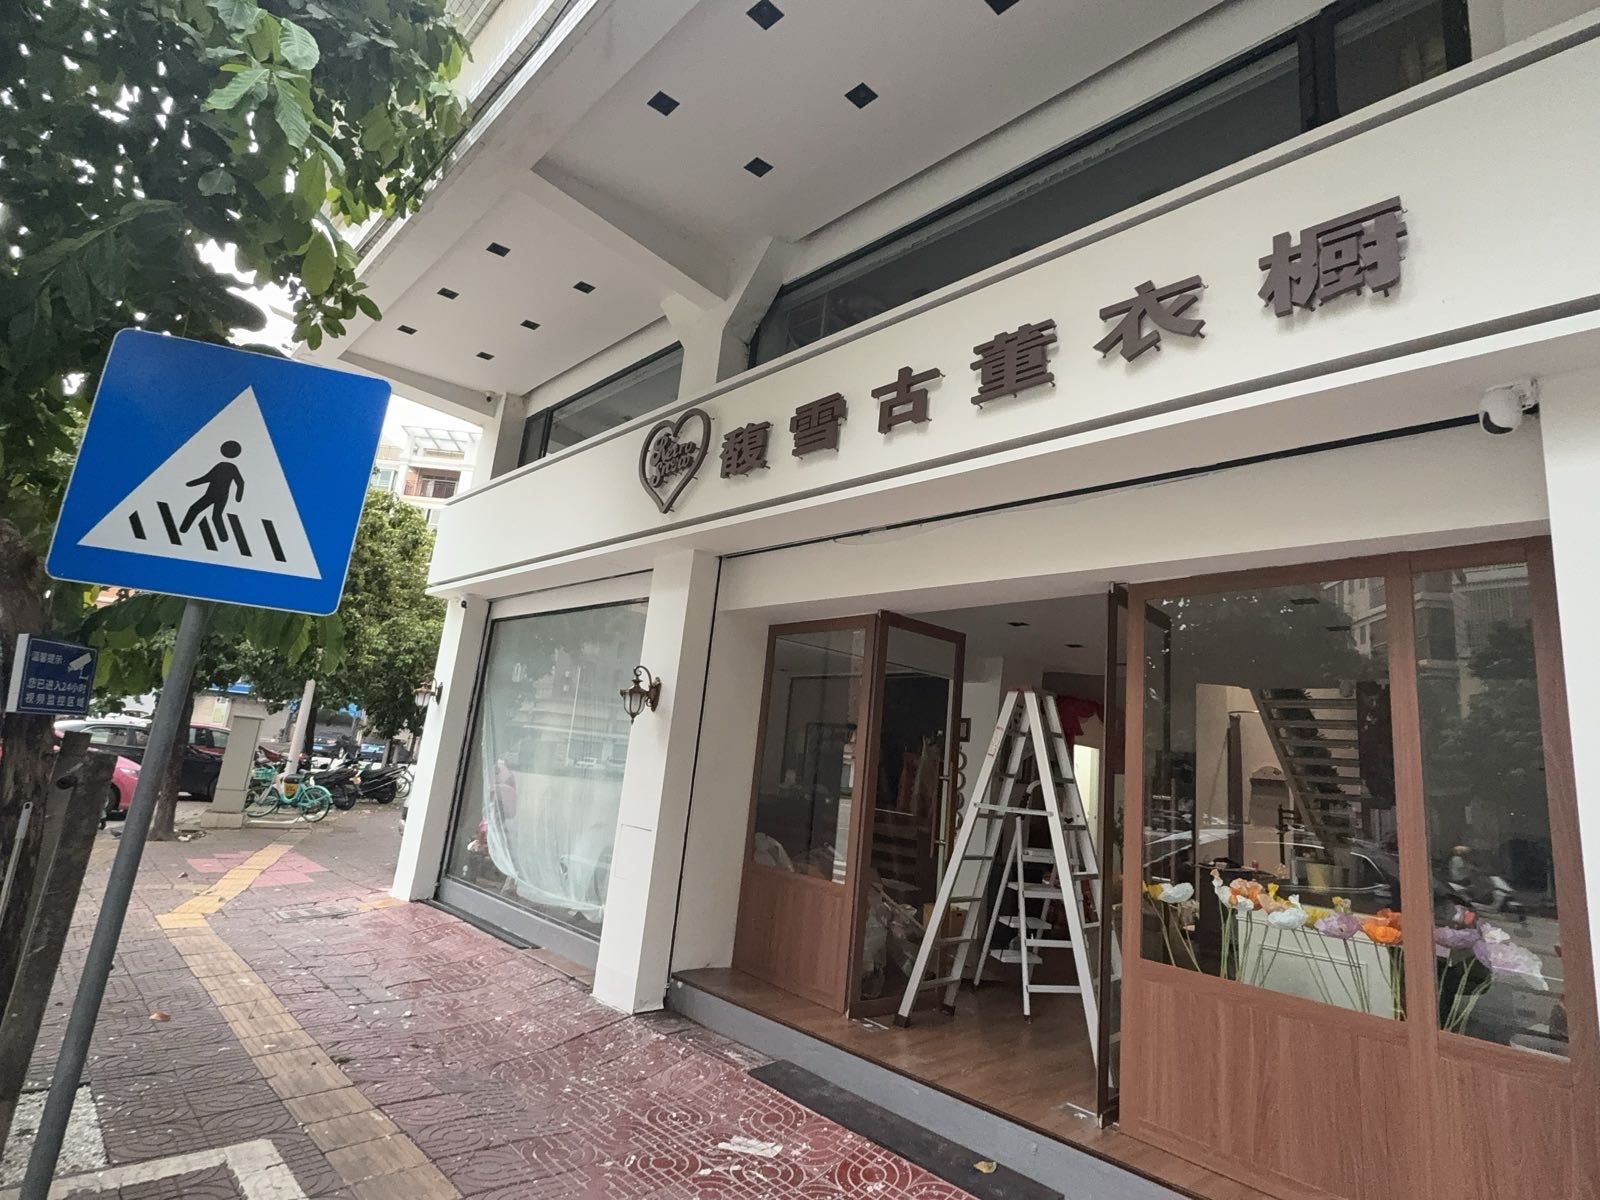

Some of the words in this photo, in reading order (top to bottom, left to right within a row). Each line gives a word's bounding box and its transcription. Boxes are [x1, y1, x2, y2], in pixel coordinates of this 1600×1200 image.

[720, 196, 1408, 479] 馥雪古董衣橱
